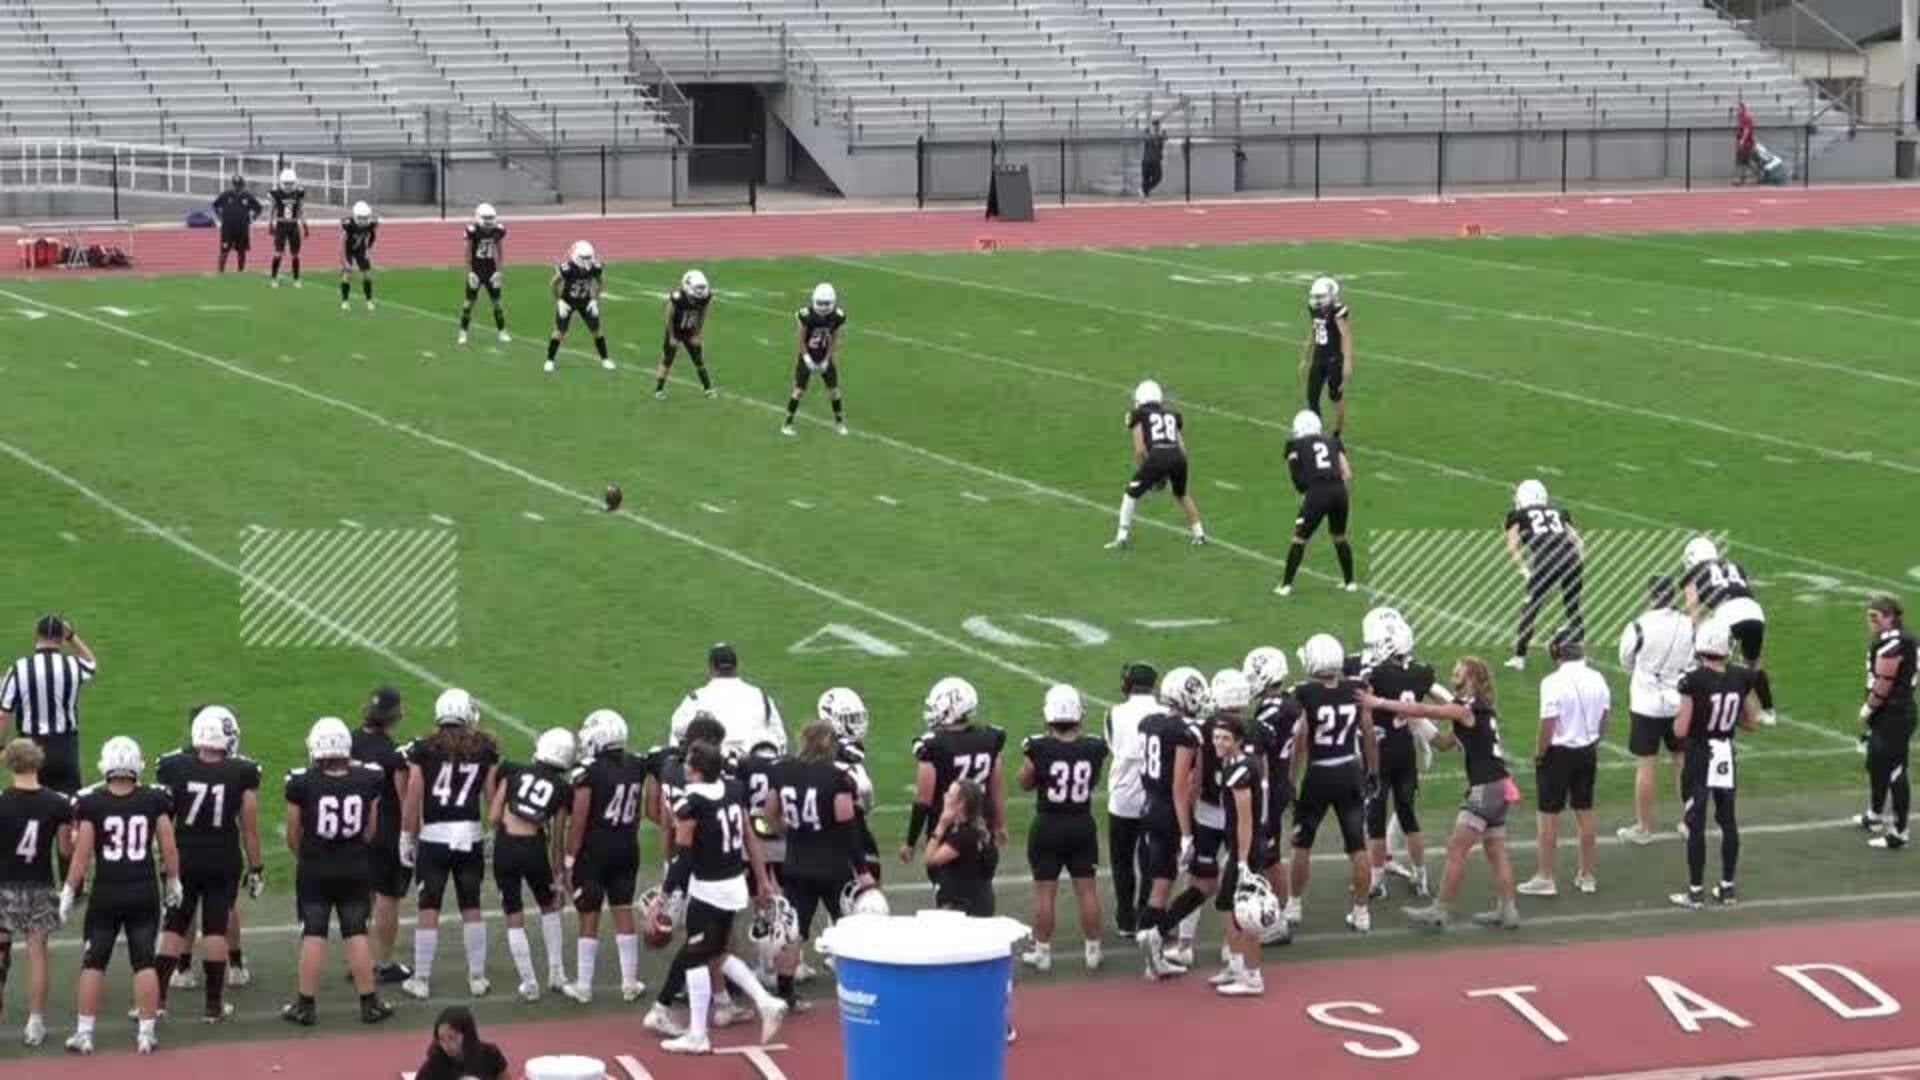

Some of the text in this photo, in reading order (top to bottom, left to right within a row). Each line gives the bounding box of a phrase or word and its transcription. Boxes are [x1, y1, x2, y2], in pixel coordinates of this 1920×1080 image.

[1149, 412, 1177, 441] 28
[1313, 442, 1331, 469] 2
[1527, 509, 1564, 535] 23
[1313, 703, 1356, 745] 27
[1708, 692, 1740, 732] 10
[185, 781, 226, 828] 71
[432, 762, 481, 807] 47
[1047, 760, 1092, 804] 38
[317, 795, 363, 840] 69
[716, 803, 743, 854] 13
[780, 786, 821, 831] 64
[16, 819, 41, 864] 4
[102, 815, 149, 862] 30
